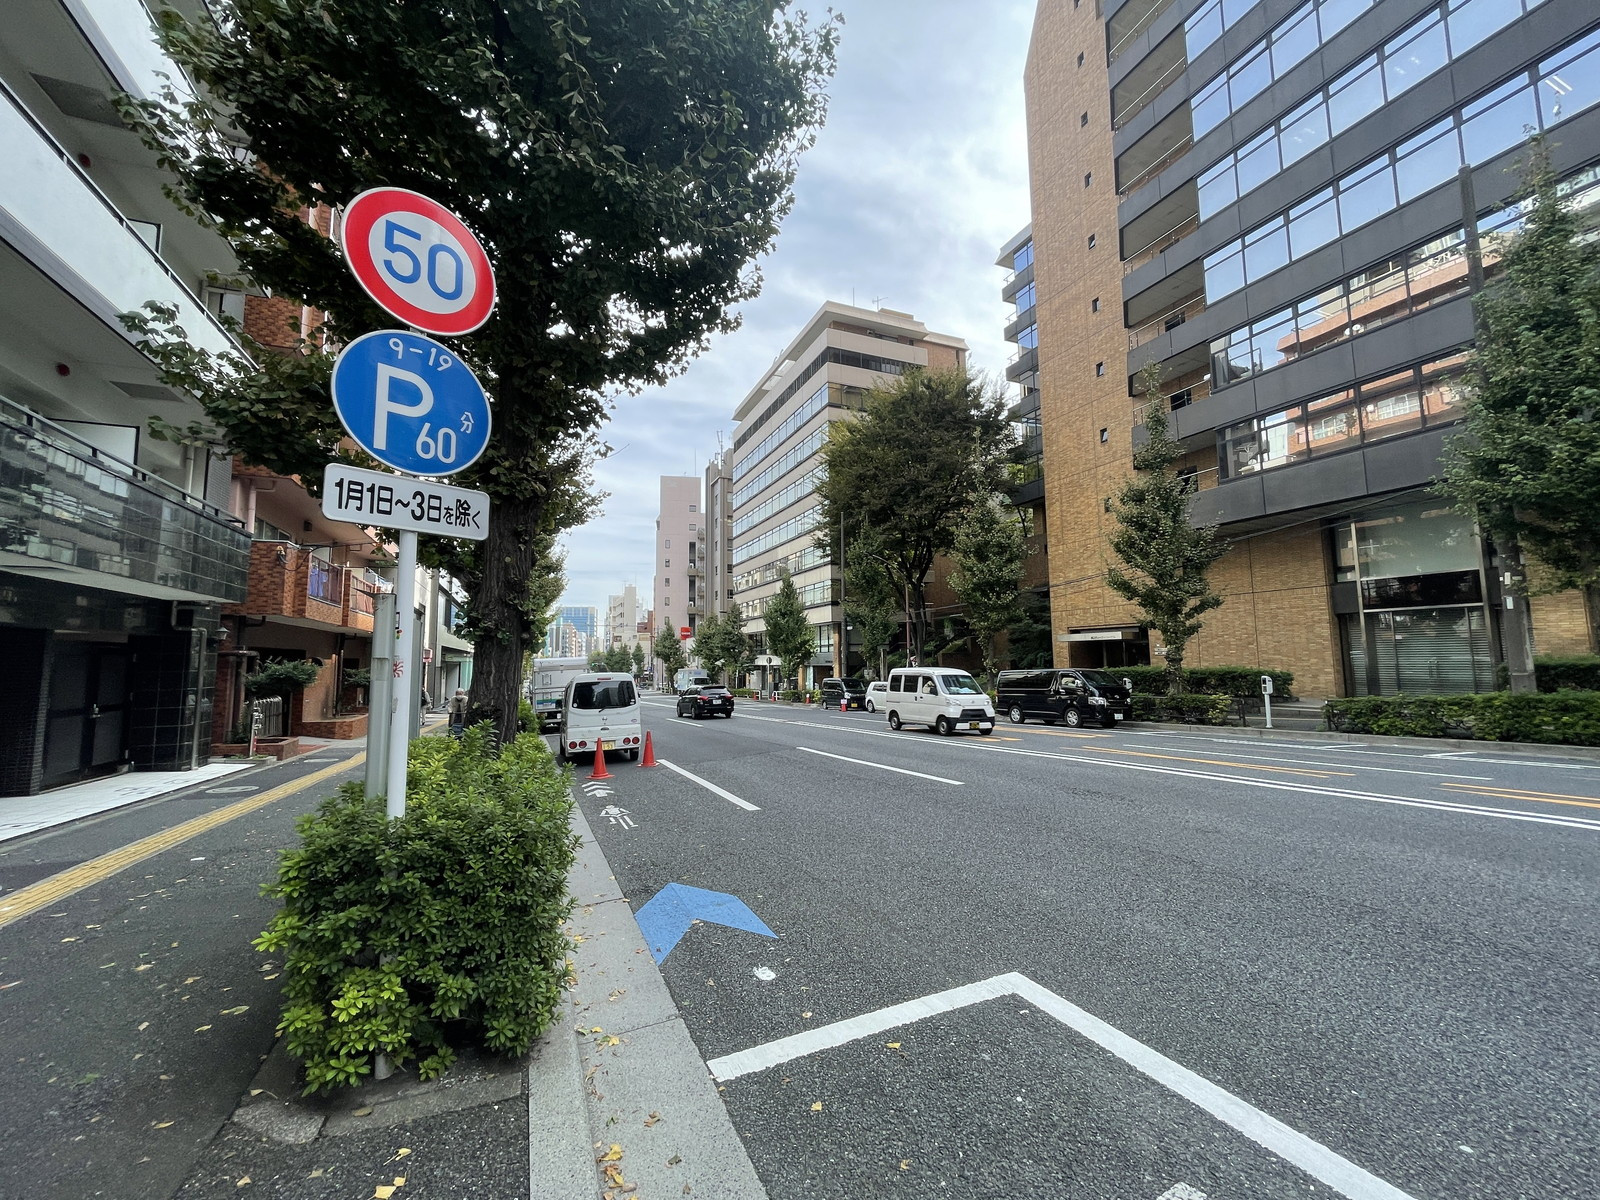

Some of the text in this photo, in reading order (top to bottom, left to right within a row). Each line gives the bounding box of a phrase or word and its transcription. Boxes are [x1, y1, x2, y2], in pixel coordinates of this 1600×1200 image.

[383, 219, 463, 300] 50
[388, 337, 453, 372] 9-19
[373, 362, 434, 451] P
